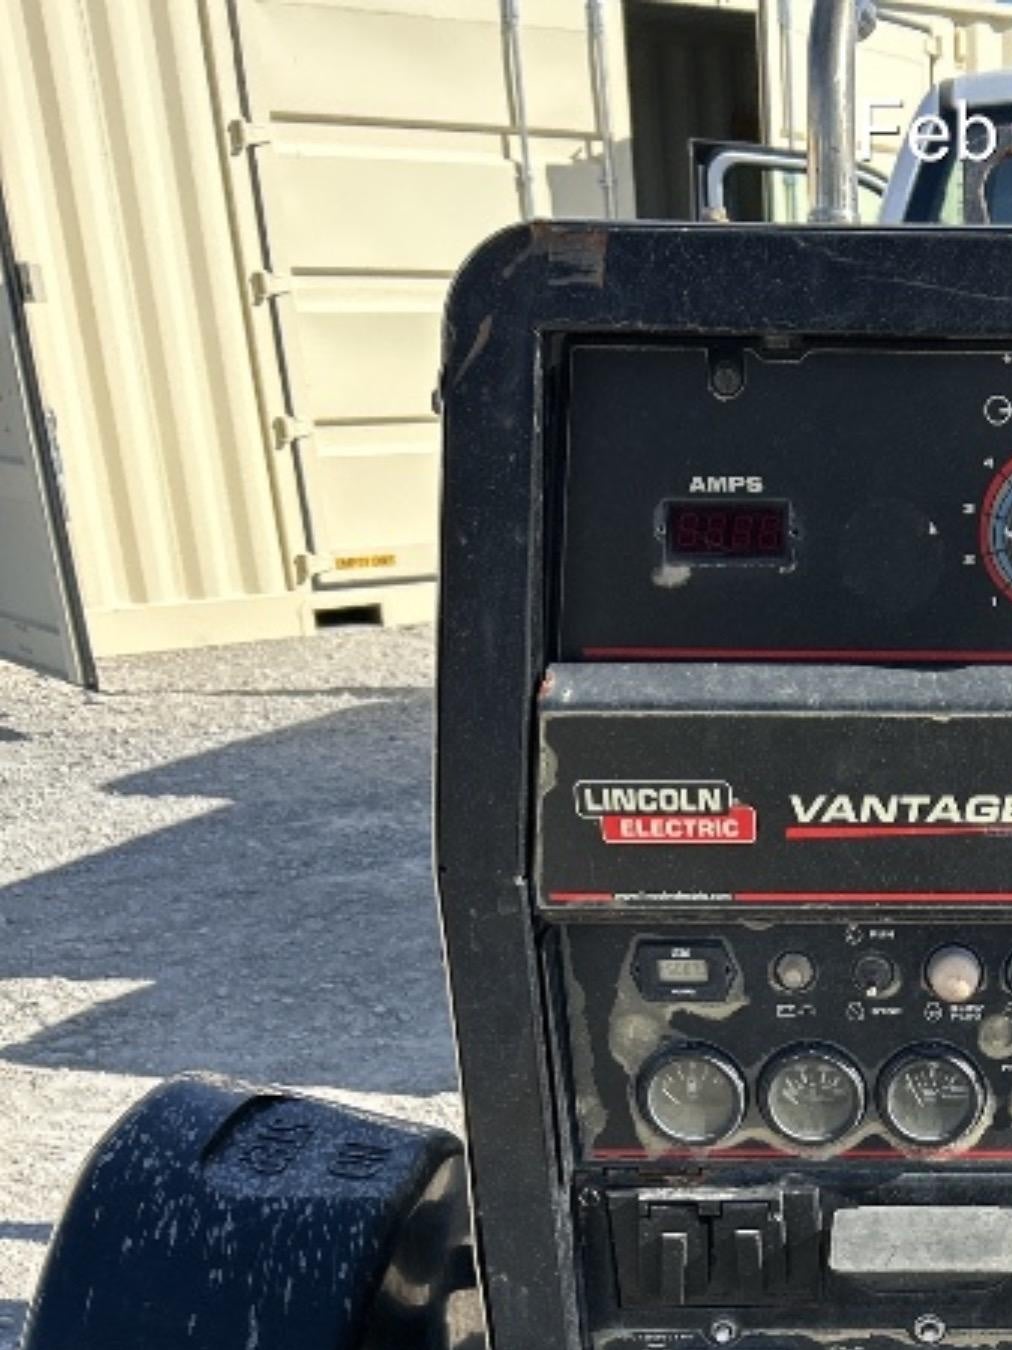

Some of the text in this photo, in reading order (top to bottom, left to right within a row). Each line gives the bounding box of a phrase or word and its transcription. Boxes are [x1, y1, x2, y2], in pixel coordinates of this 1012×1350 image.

[689, 476, 763, 493] AMPS
[584, 788, 722, 813] LINCOLN
[620, 818, 740, 838] ELECTRIC
